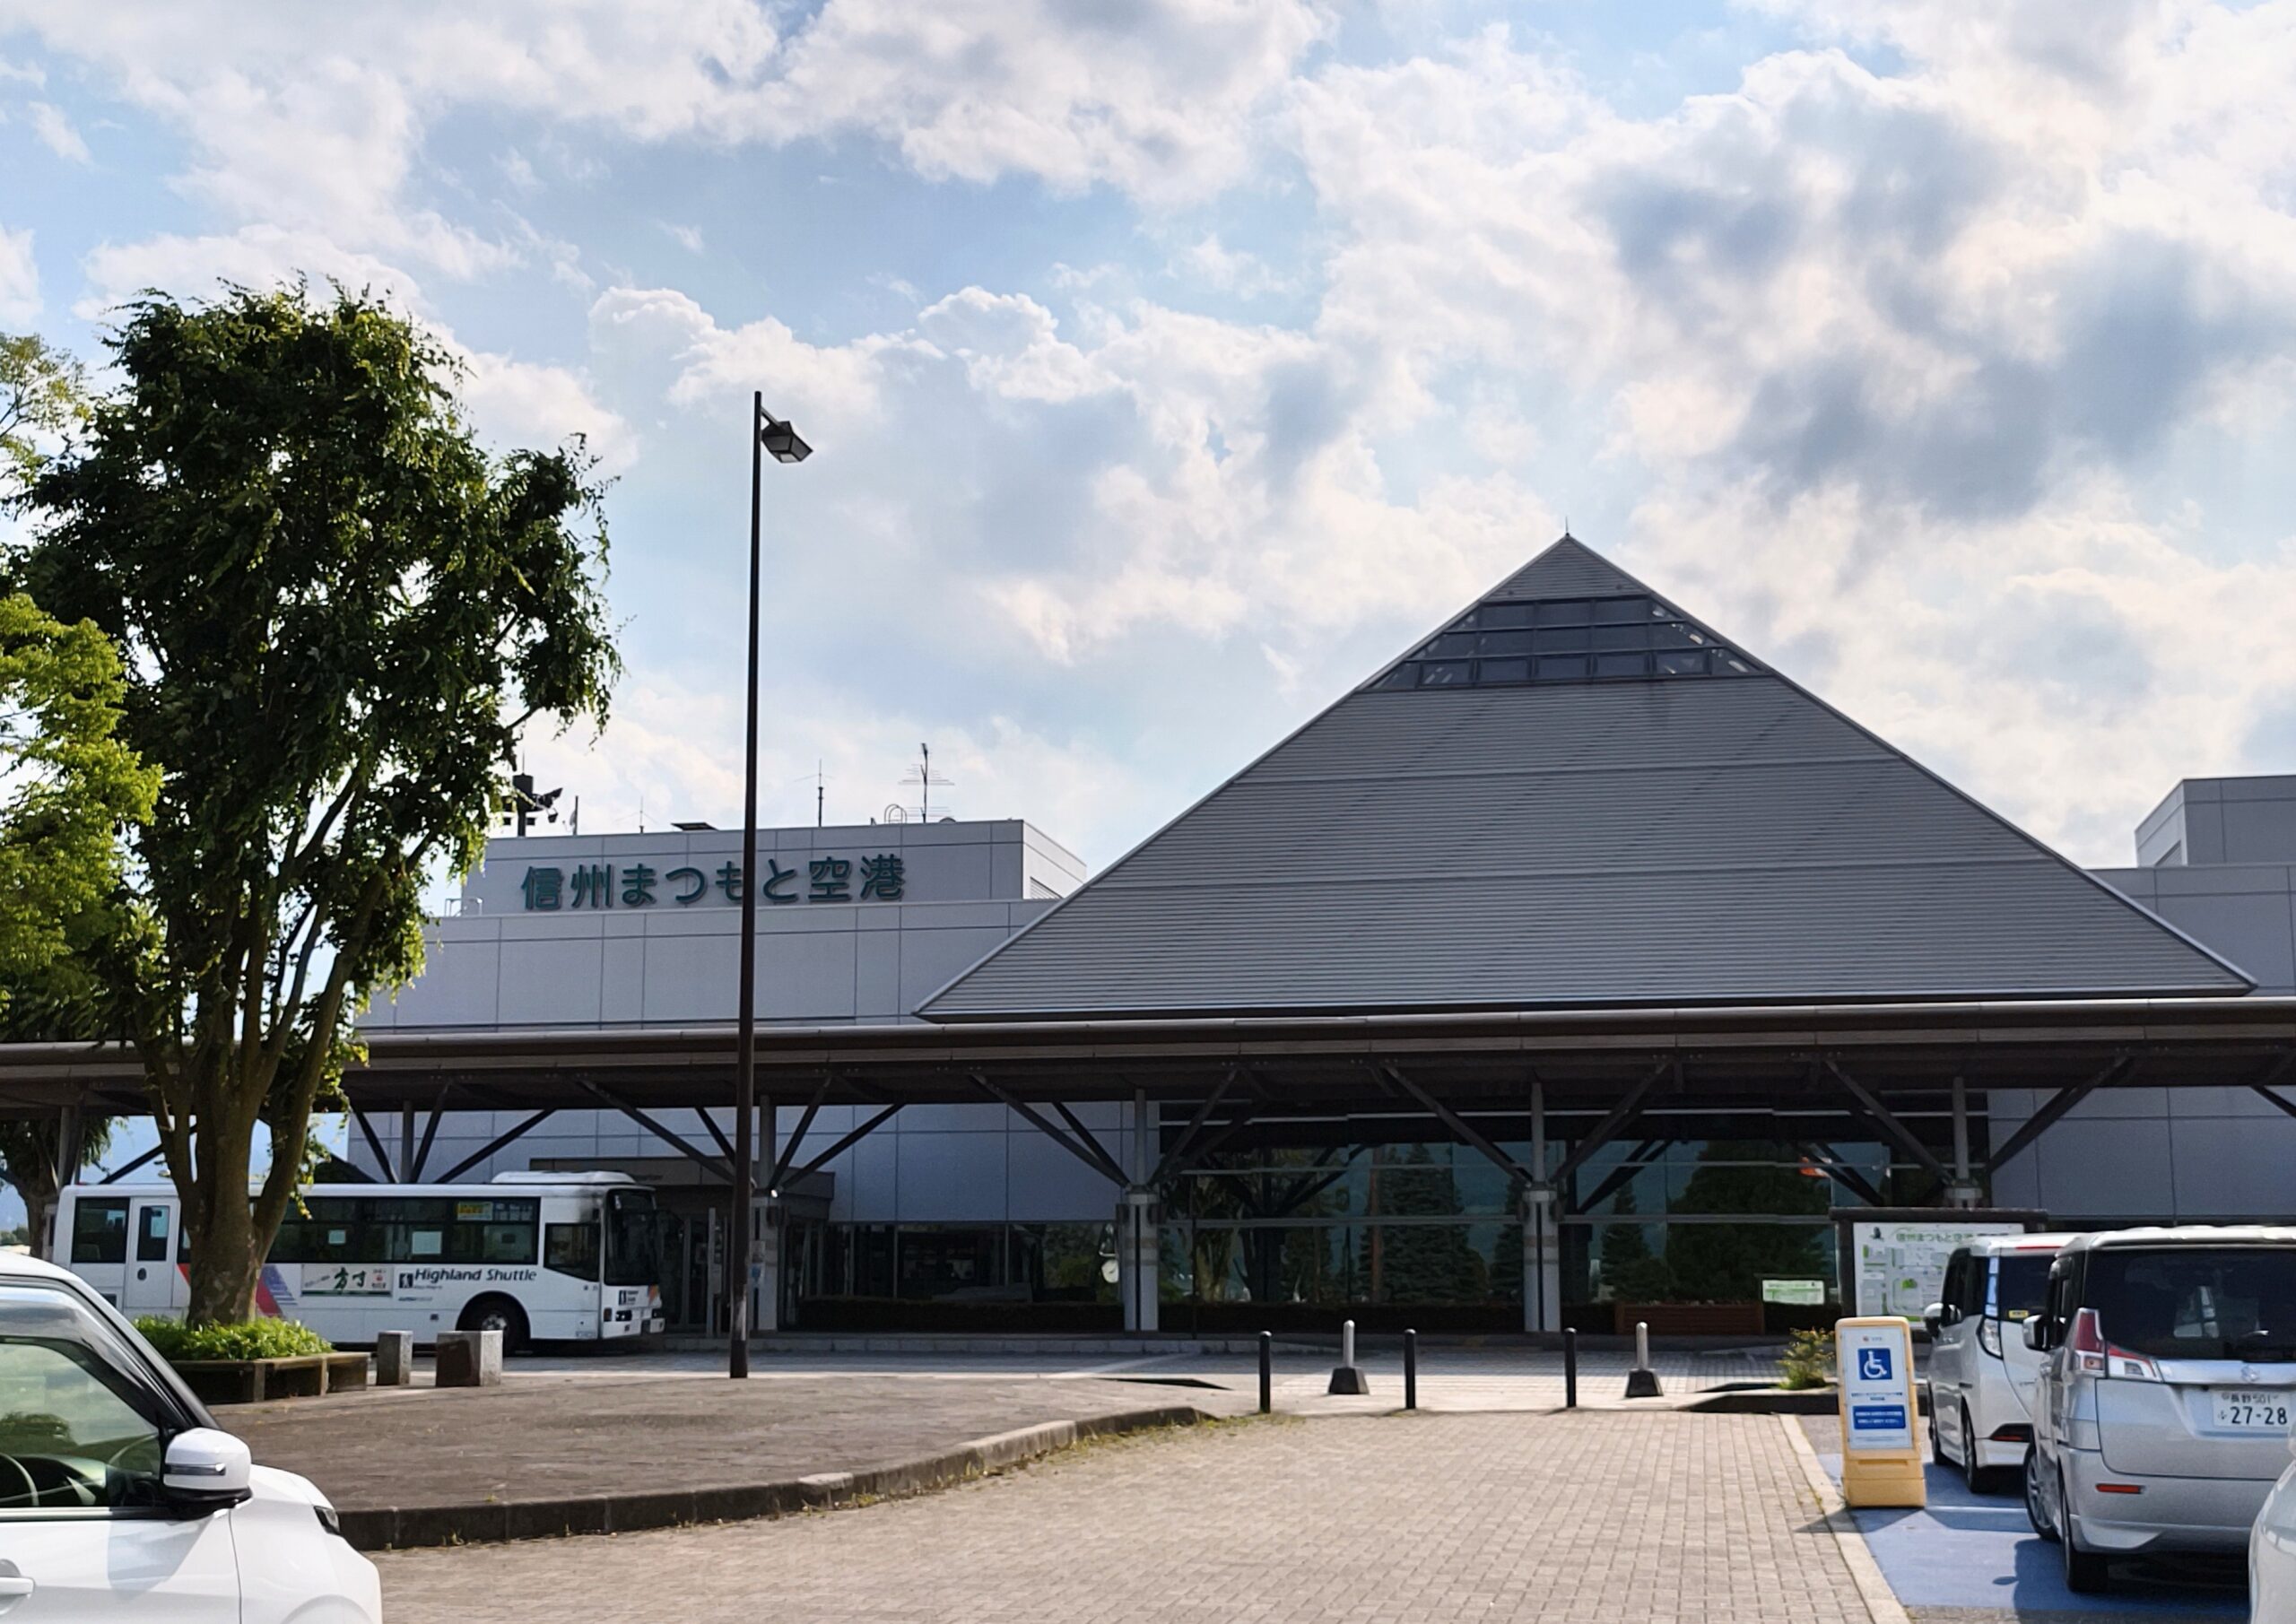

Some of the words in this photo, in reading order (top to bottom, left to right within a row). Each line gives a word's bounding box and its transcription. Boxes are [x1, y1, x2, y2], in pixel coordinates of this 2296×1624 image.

[520, 853, 907, 911] 信州まつもと空港
[414, 1268, 483, 1283] Highland
[485, 1268, 537, 1281] Shuttle
[2230, 1405, 2288, 1426] 27-28
